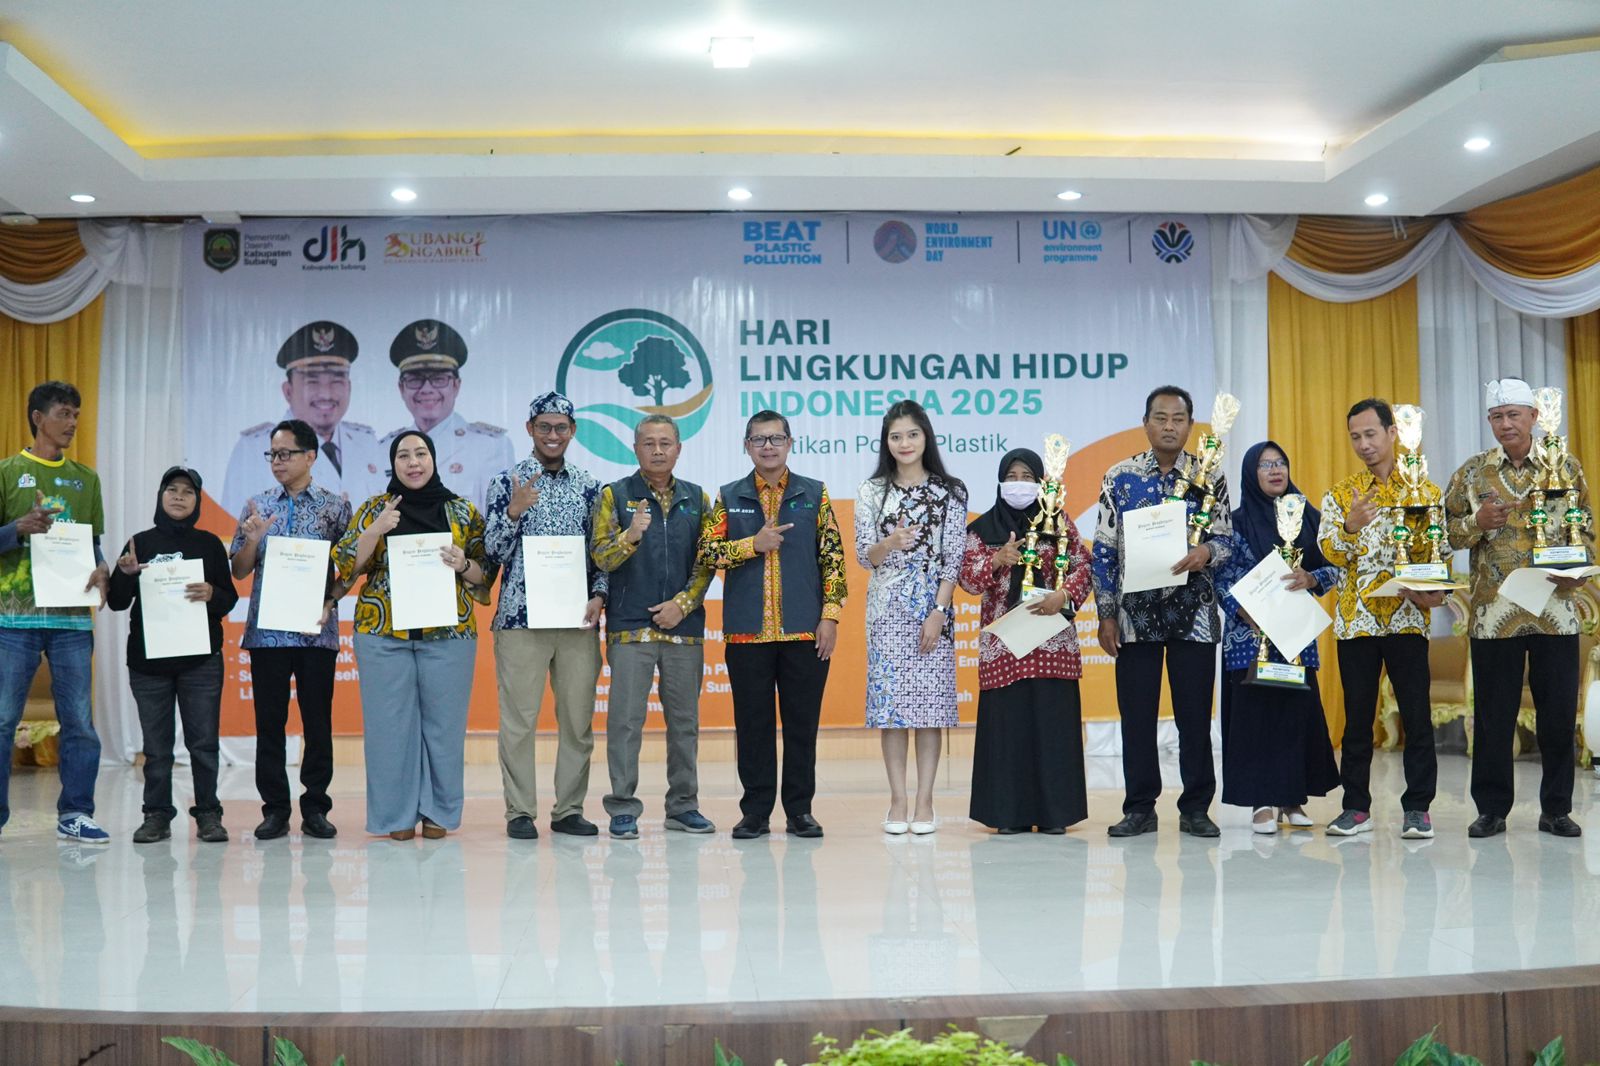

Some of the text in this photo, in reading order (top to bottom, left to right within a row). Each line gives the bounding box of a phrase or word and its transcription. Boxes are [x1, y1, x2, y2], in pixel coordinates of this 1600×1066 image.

[743, 221, 821, 241] BEAT
[925, 222, 958, 235] WORLD
[1042, 220, 1077, 240] UN
[244, 233, 290, 241] Pemerintah
[925, 236, 993, 249] ENVIRONMENT
[754, 243, 812, 253] PLASTIC
[1043, 243, 1102, 252] environment
[244, 250, 292, 259] Kabupaten
[743, 254, 822, 265] POLLUTION
[925, 250, 944, 262] DAY
[1043, 253, 1098, 264] programme
[244, 258, 278, 266] Subang
[739, 319, 831, 345] HARI
[739, 352, 1129, 382] LINGKUNGAN HIDUP
[951, 388, 1043, 416] 2025
